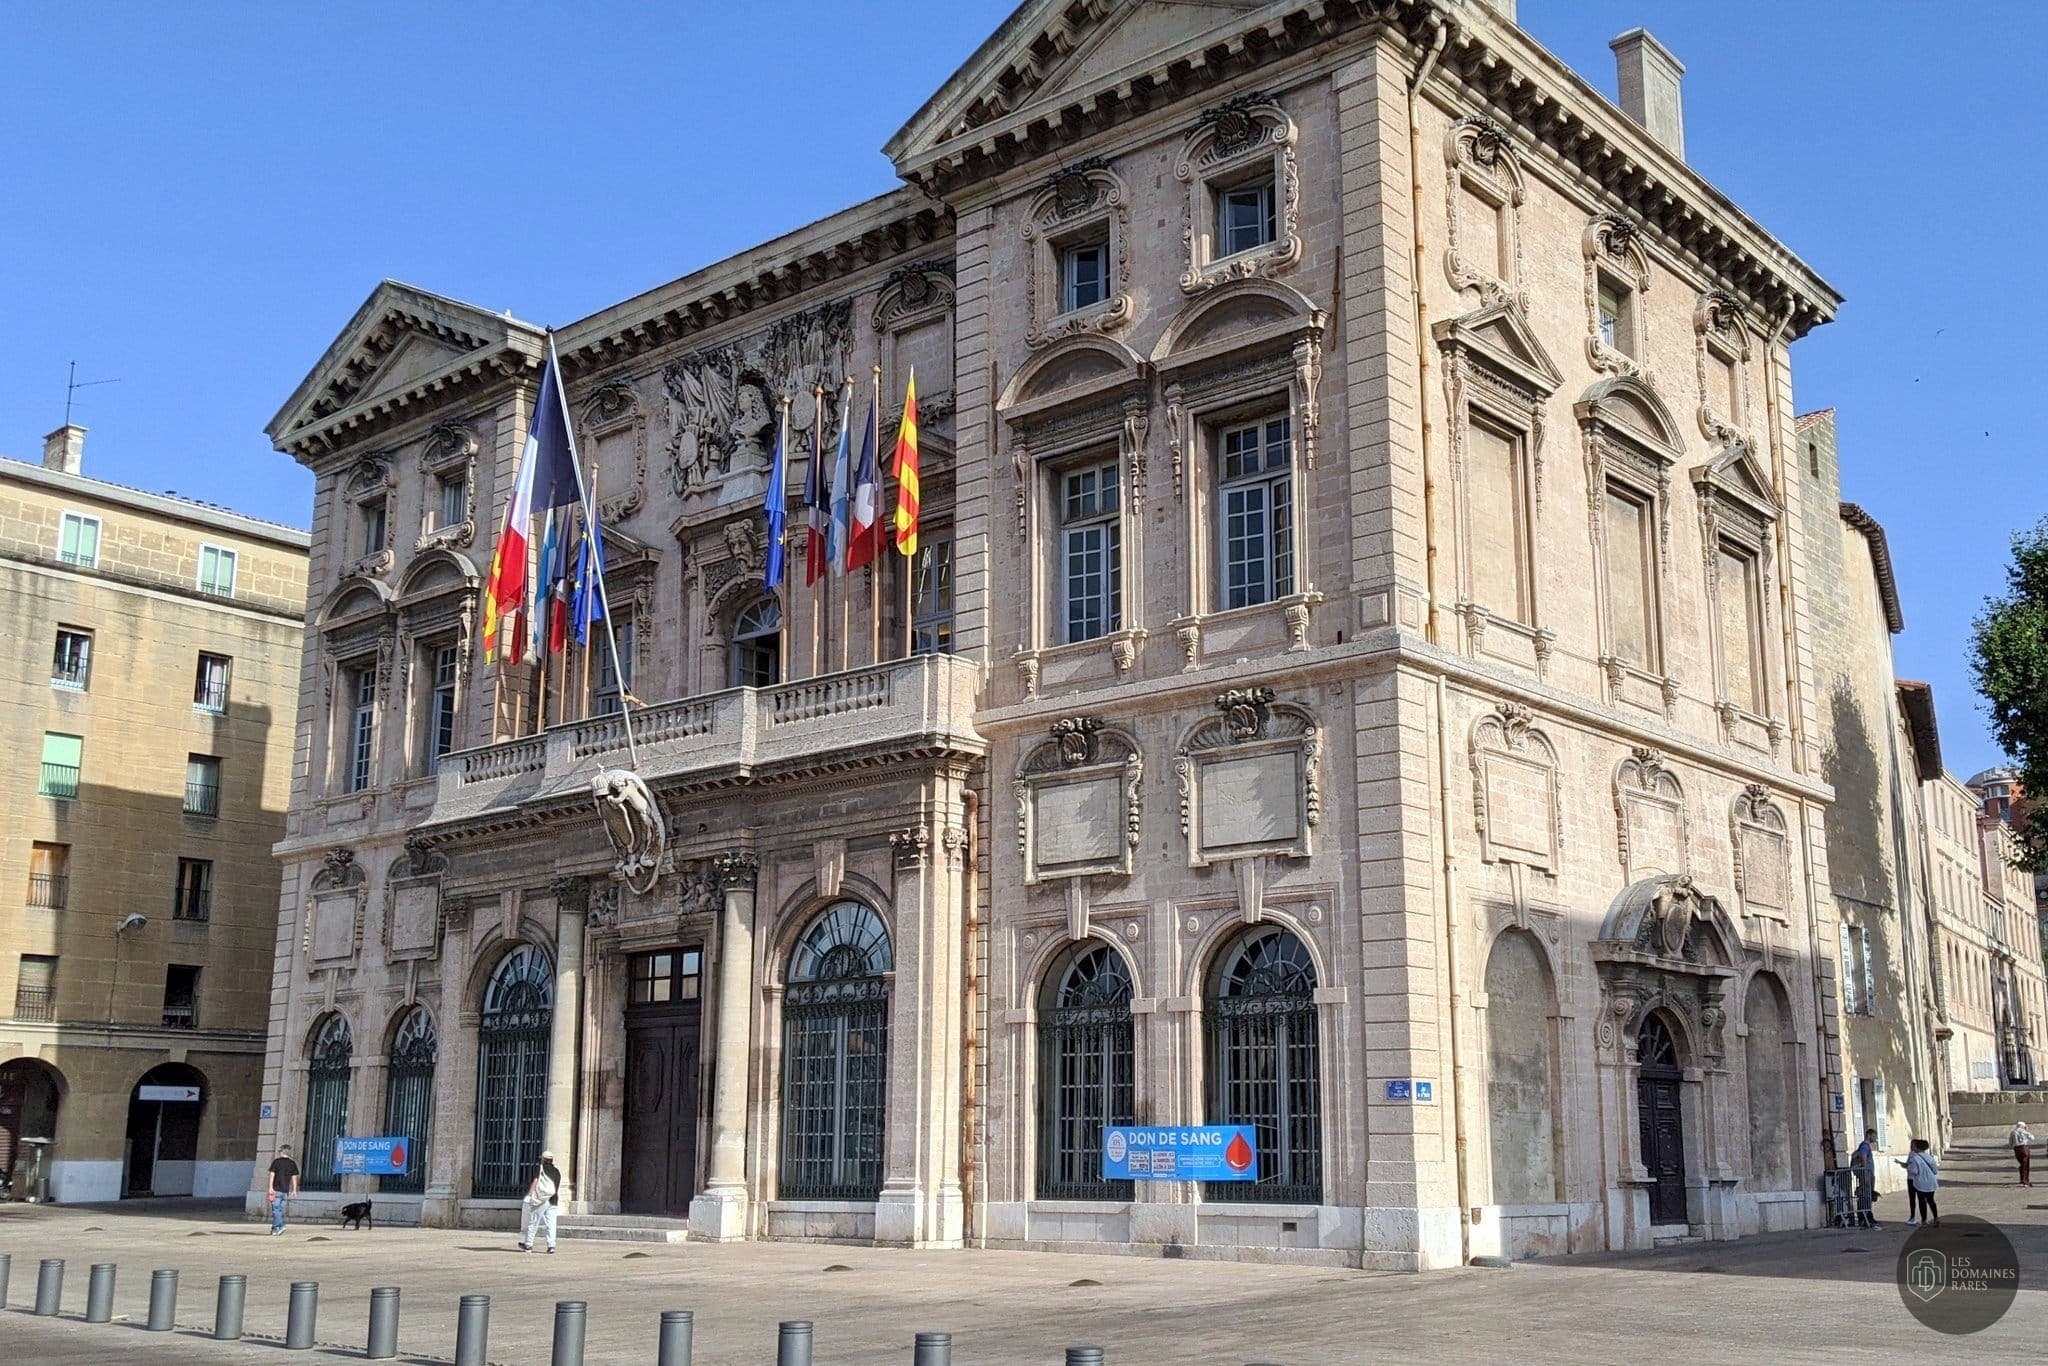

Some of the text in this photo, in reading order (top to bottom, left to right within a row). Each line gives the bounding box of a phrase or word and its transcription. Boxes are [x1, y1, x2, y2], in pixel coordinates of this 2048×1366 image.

[1129, 1132, 1156, 1145] DON
[1159, 1132, 1177, 1145] DE
[1180, 1132, 1222, 1145] SANG
[343, 1141, 390, 1150] DON DE SANG
